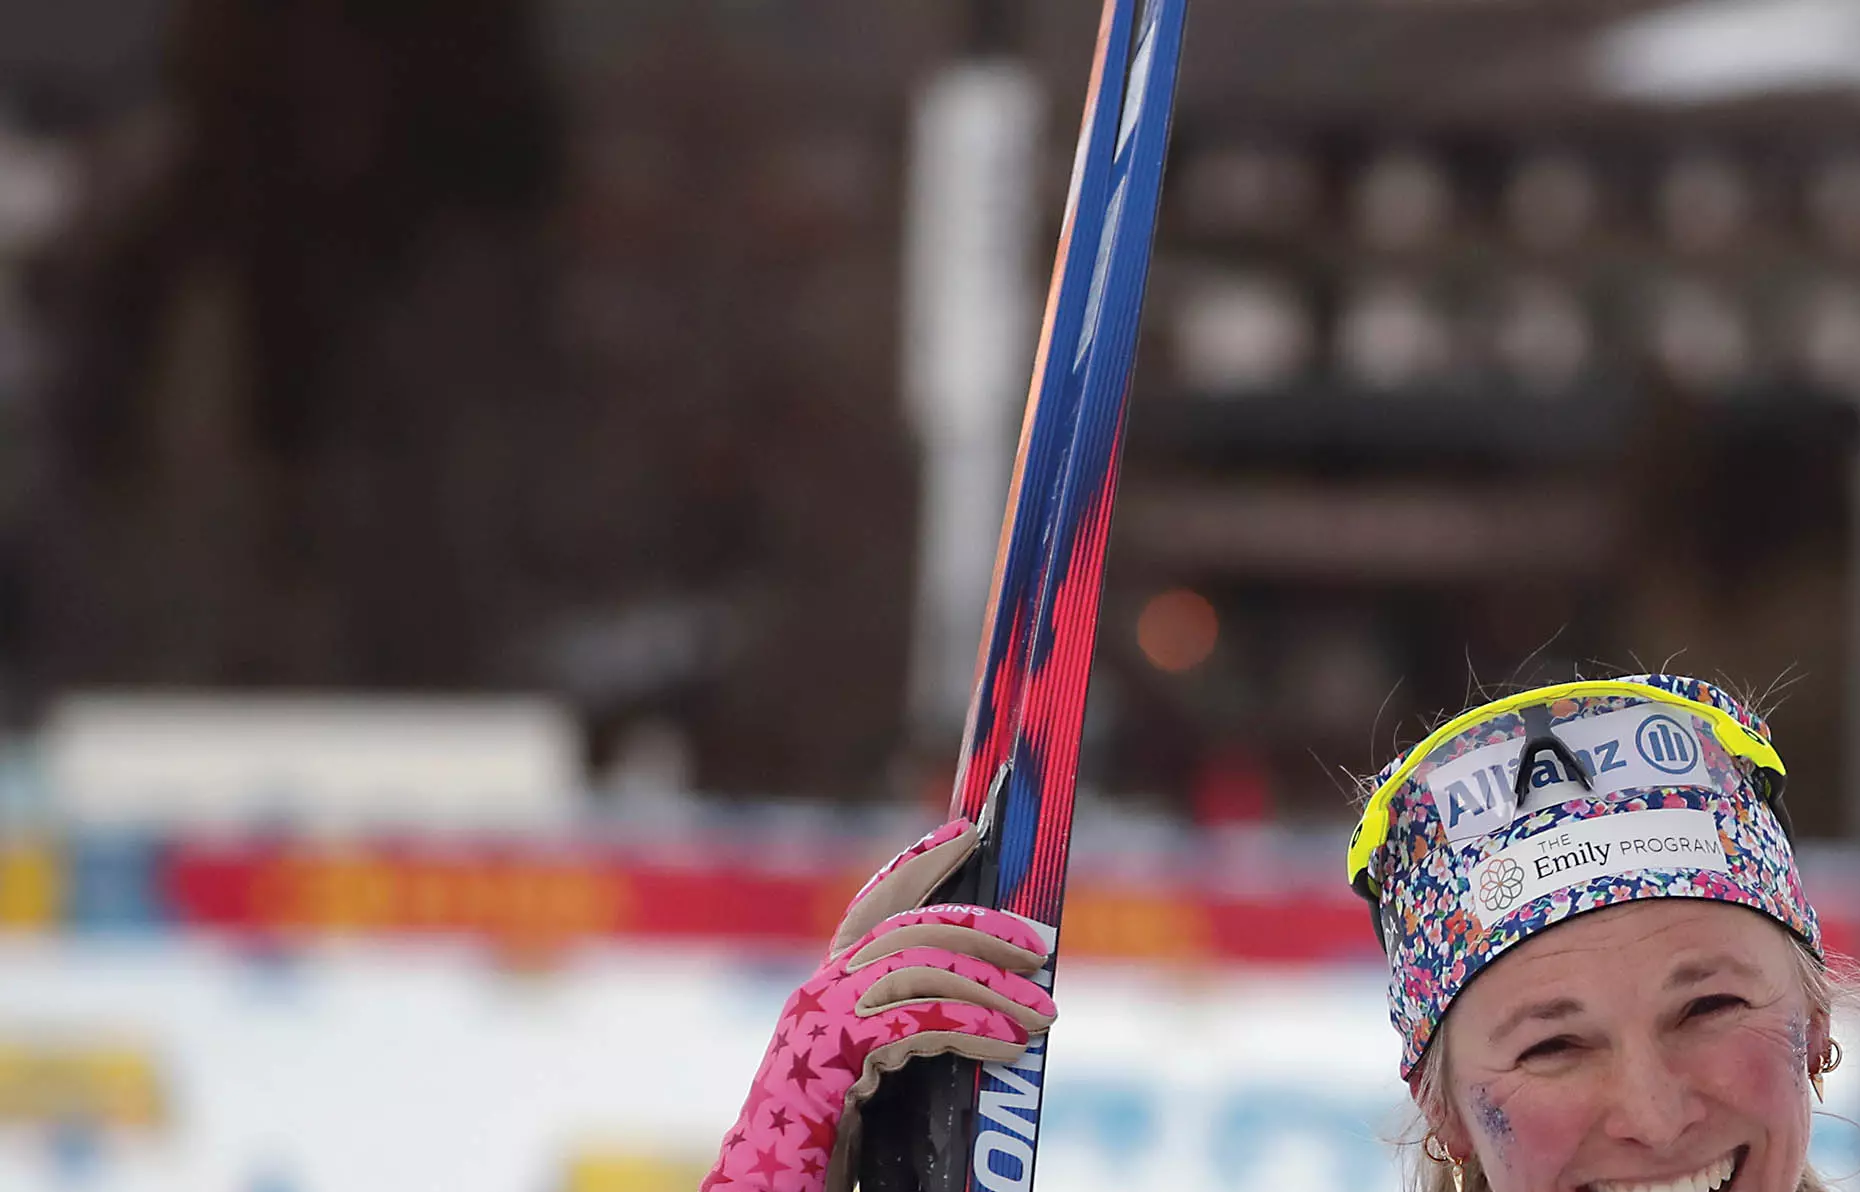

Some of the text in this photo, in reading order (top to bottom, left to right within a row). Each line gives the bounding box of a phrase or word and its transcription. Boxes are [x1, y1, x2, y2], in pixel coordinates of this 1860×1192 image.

[1533, 836, 1721, 882] Emily PROGRAM
[1538, 833, 1572, 853] THE
